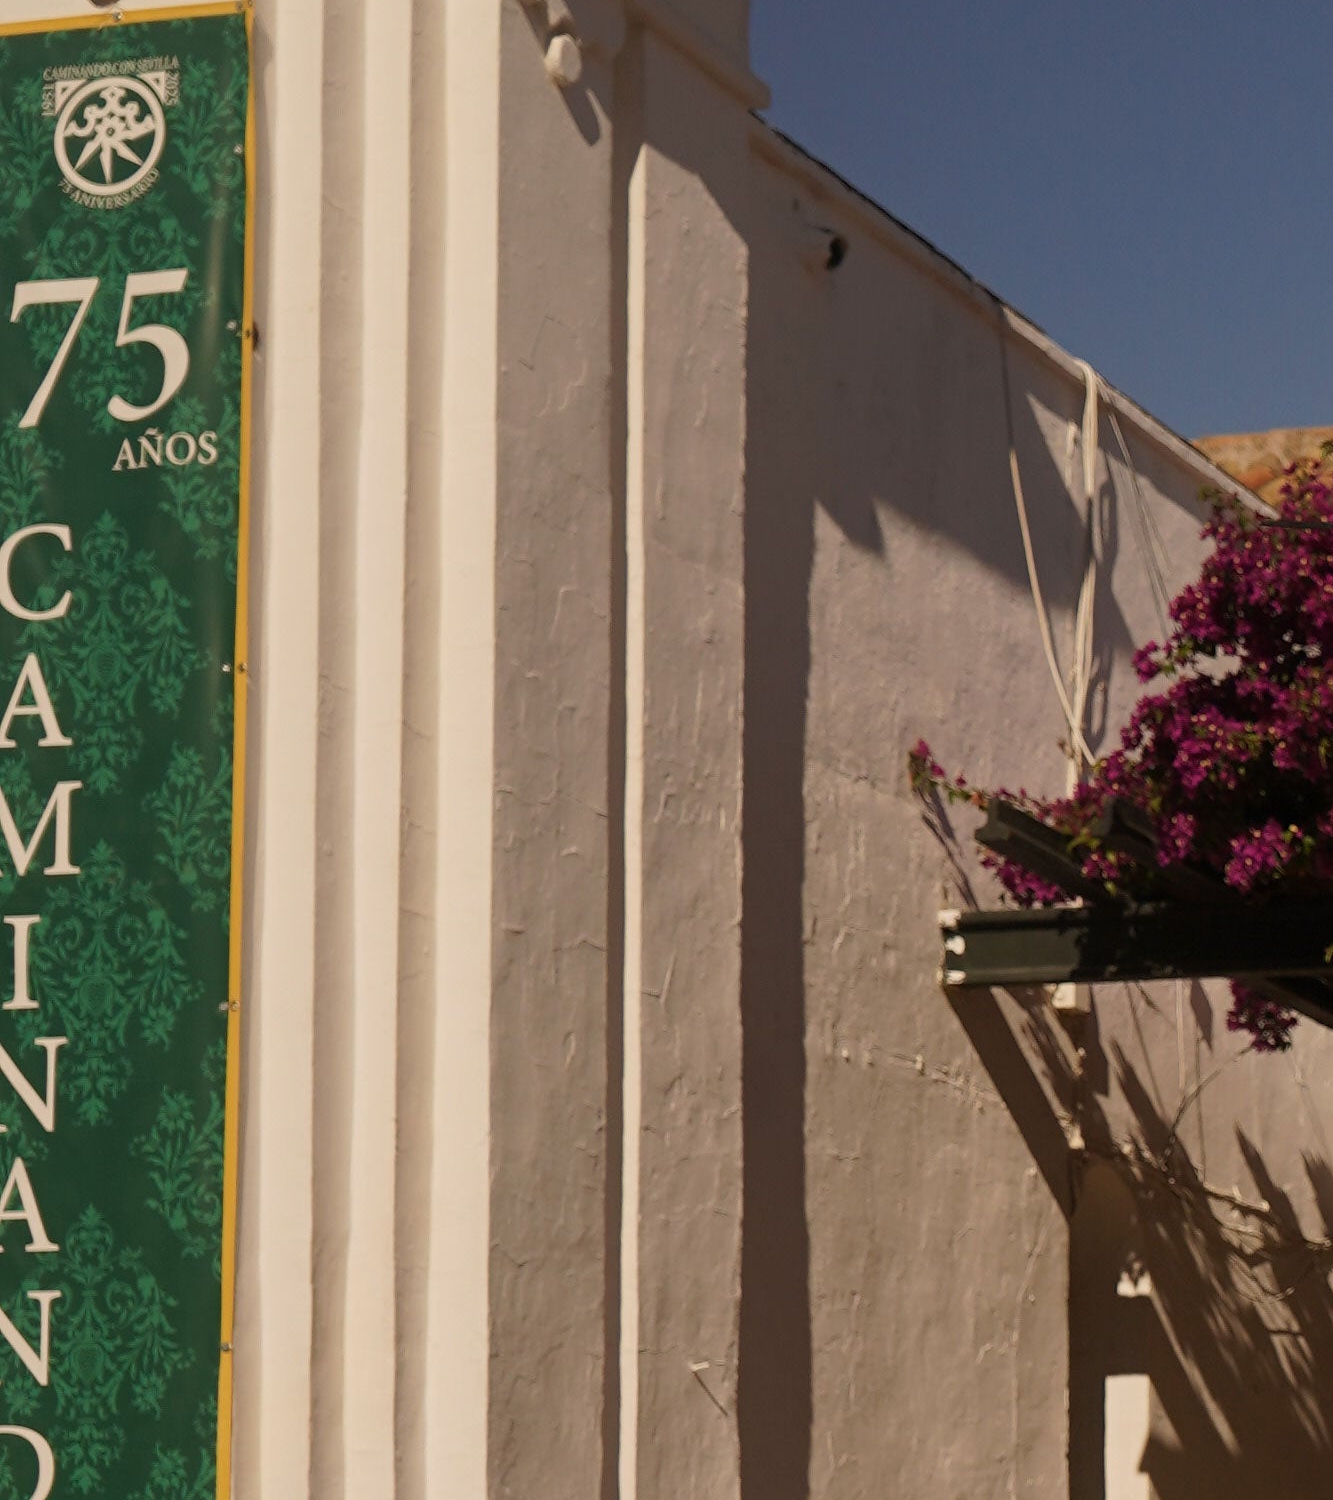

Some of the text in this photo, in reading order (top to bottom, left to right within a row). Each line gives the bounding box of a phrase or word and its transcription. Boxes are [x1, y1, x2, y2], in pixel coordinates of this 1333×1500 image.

[43, 60, 110, 80] CAMINANDO
[112, 59, 137, 75] CON
[69, 167, 160, 210] ANIVERSARIO
[9, 268, 190, 429] 75
[112, 426, 219, 472] AÑOS
